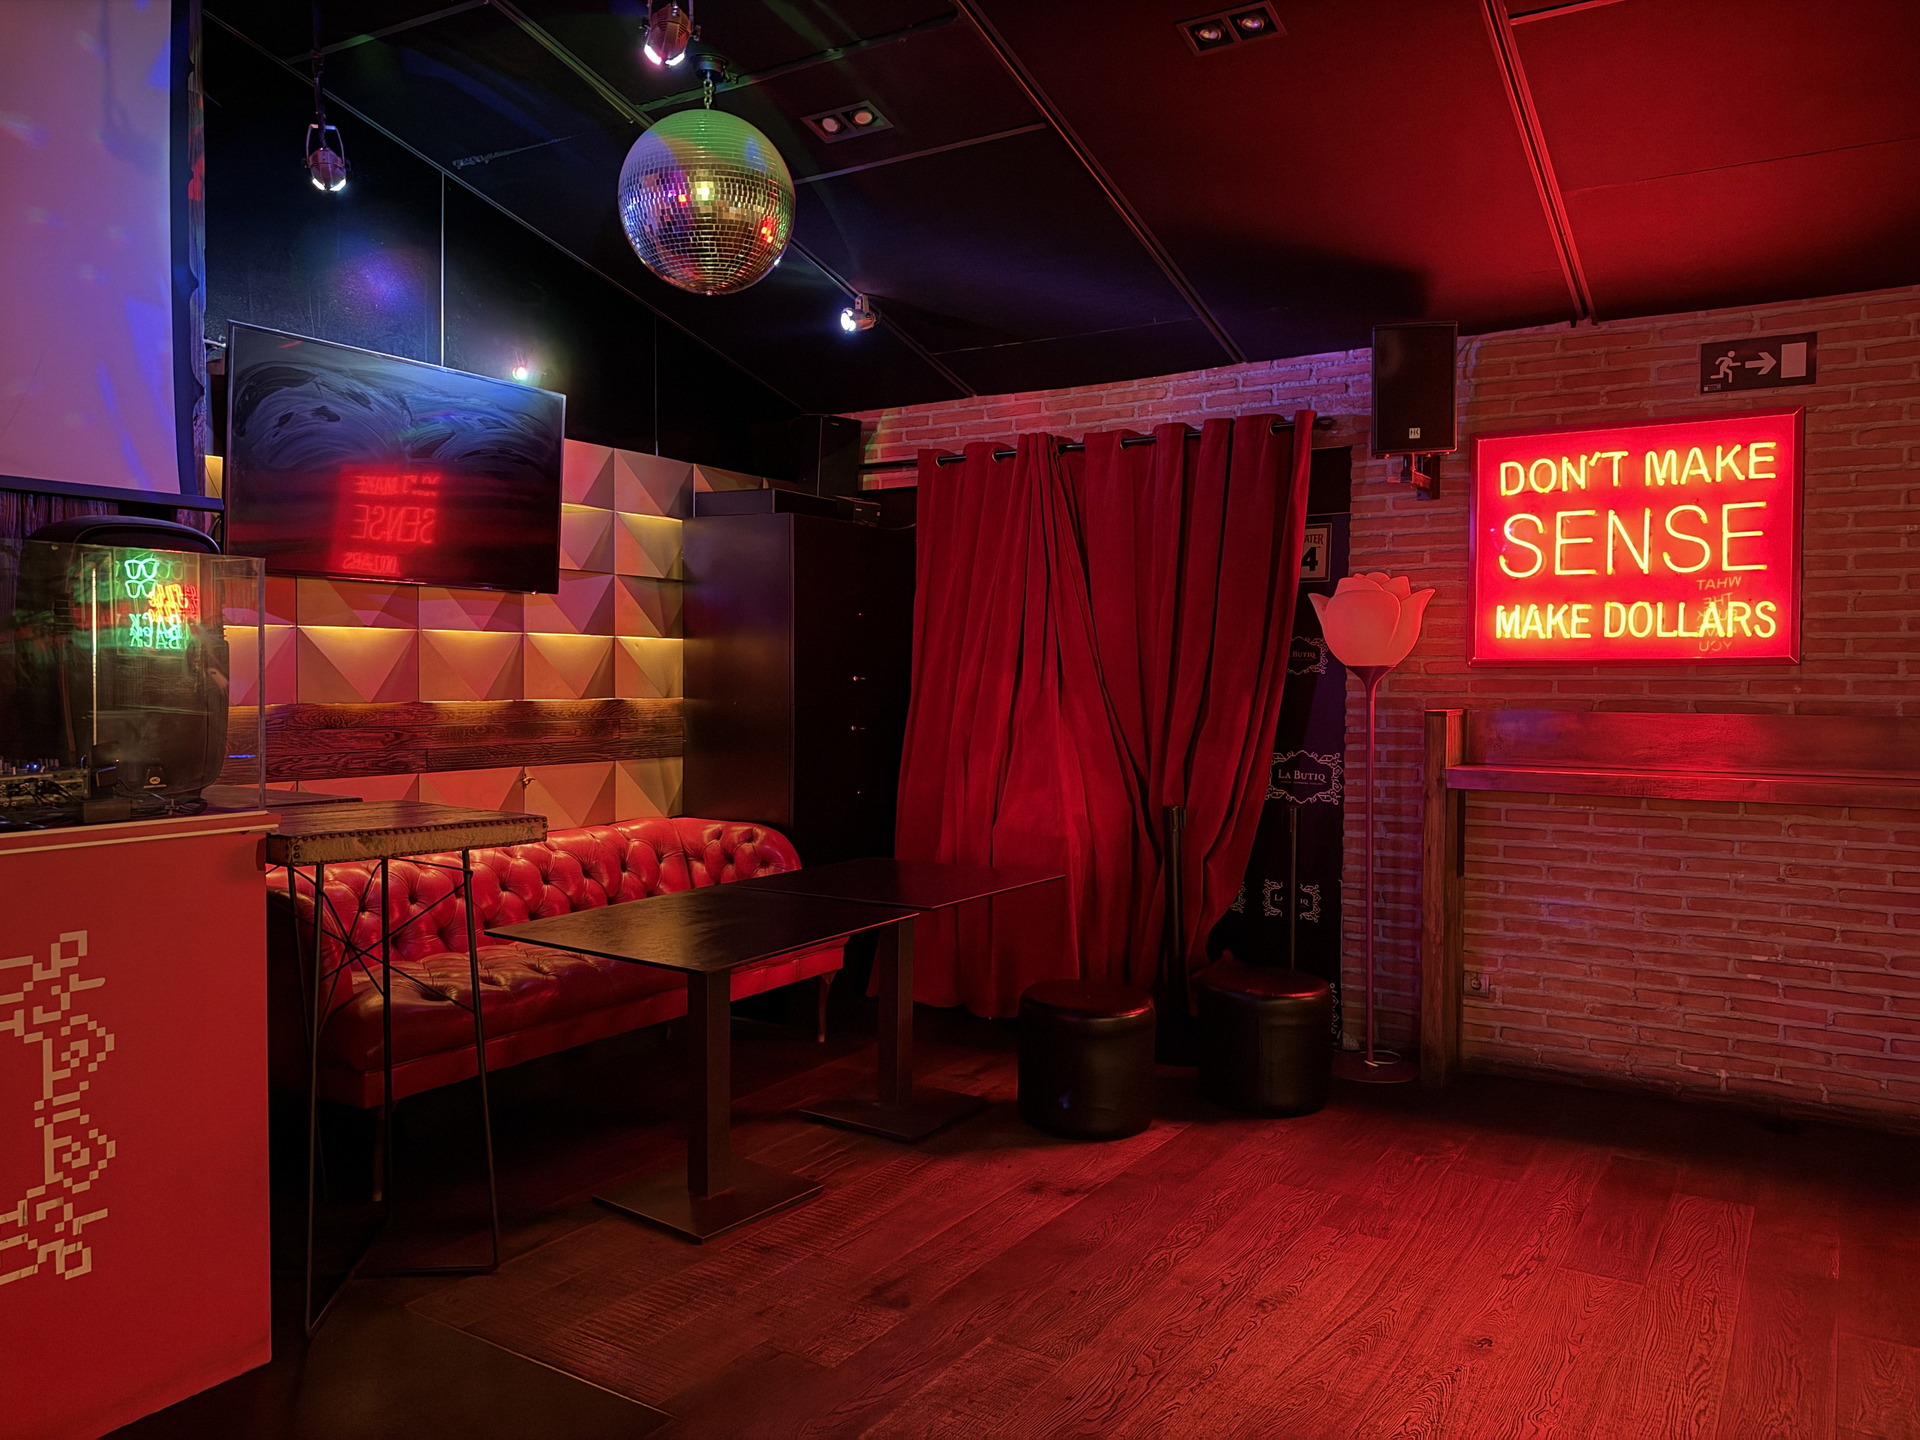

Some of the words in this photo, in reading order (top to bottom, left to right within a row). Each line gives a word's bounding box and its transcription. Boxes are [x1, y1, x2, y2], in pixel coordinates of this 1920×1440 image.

[1499, 450, 1629, 496] DON'T
[1645, 441, 1776, 486] MAKE
[1304, 533, 1324, 545] ATER
[1498, 501, 1768, 578] SENSE
[1495, 603, 1592, 639] MAKE
[1604, 601, 1777, 639] DOLLARS
